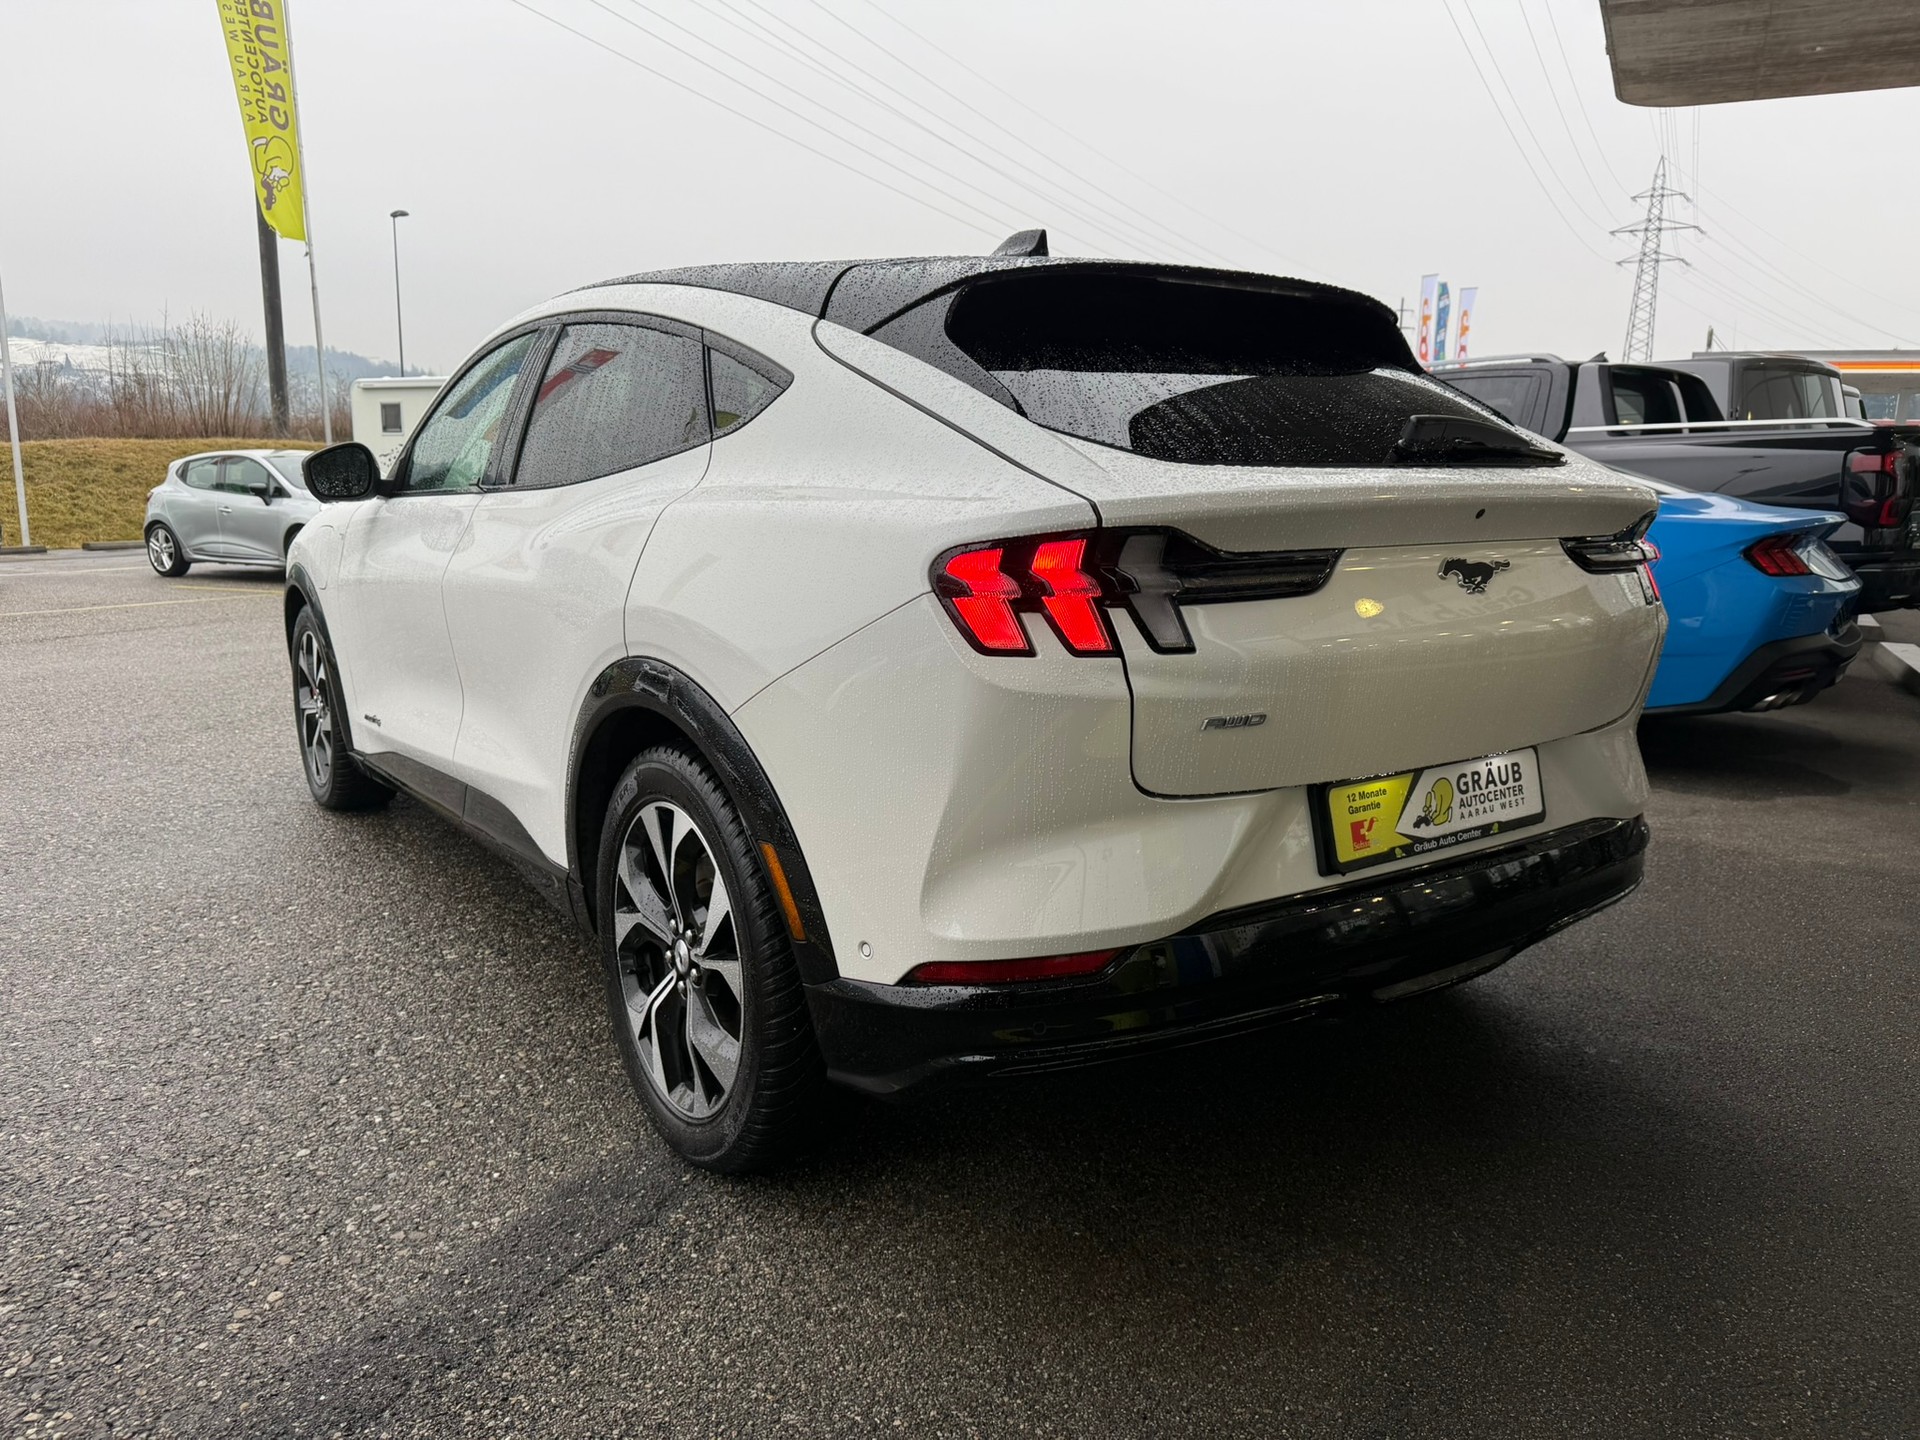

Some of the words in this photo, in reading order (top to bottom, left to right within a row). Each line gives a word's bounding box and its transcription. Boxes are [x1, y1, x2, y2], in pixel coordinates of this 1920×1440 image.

[1200, 713, 1267, 731] AWD
[1456, 761, 1523, 796] GRÄUB
[1346, 792, 1357, 803] 12
[1358, 786, 1388, 801] Monate
[1458, 784, 1525, 810] AUTOCENTER
[1348, 801, 1381, 816] Garantie
[1460, 804, 1495, 820] AARAU
[1500, 797, 1526, 811] WEST
[1413, 837, 1438, 852] Gräub
[1439, 833, 1457, 847] Auto
[1457, 827, 1482, 843] Center
